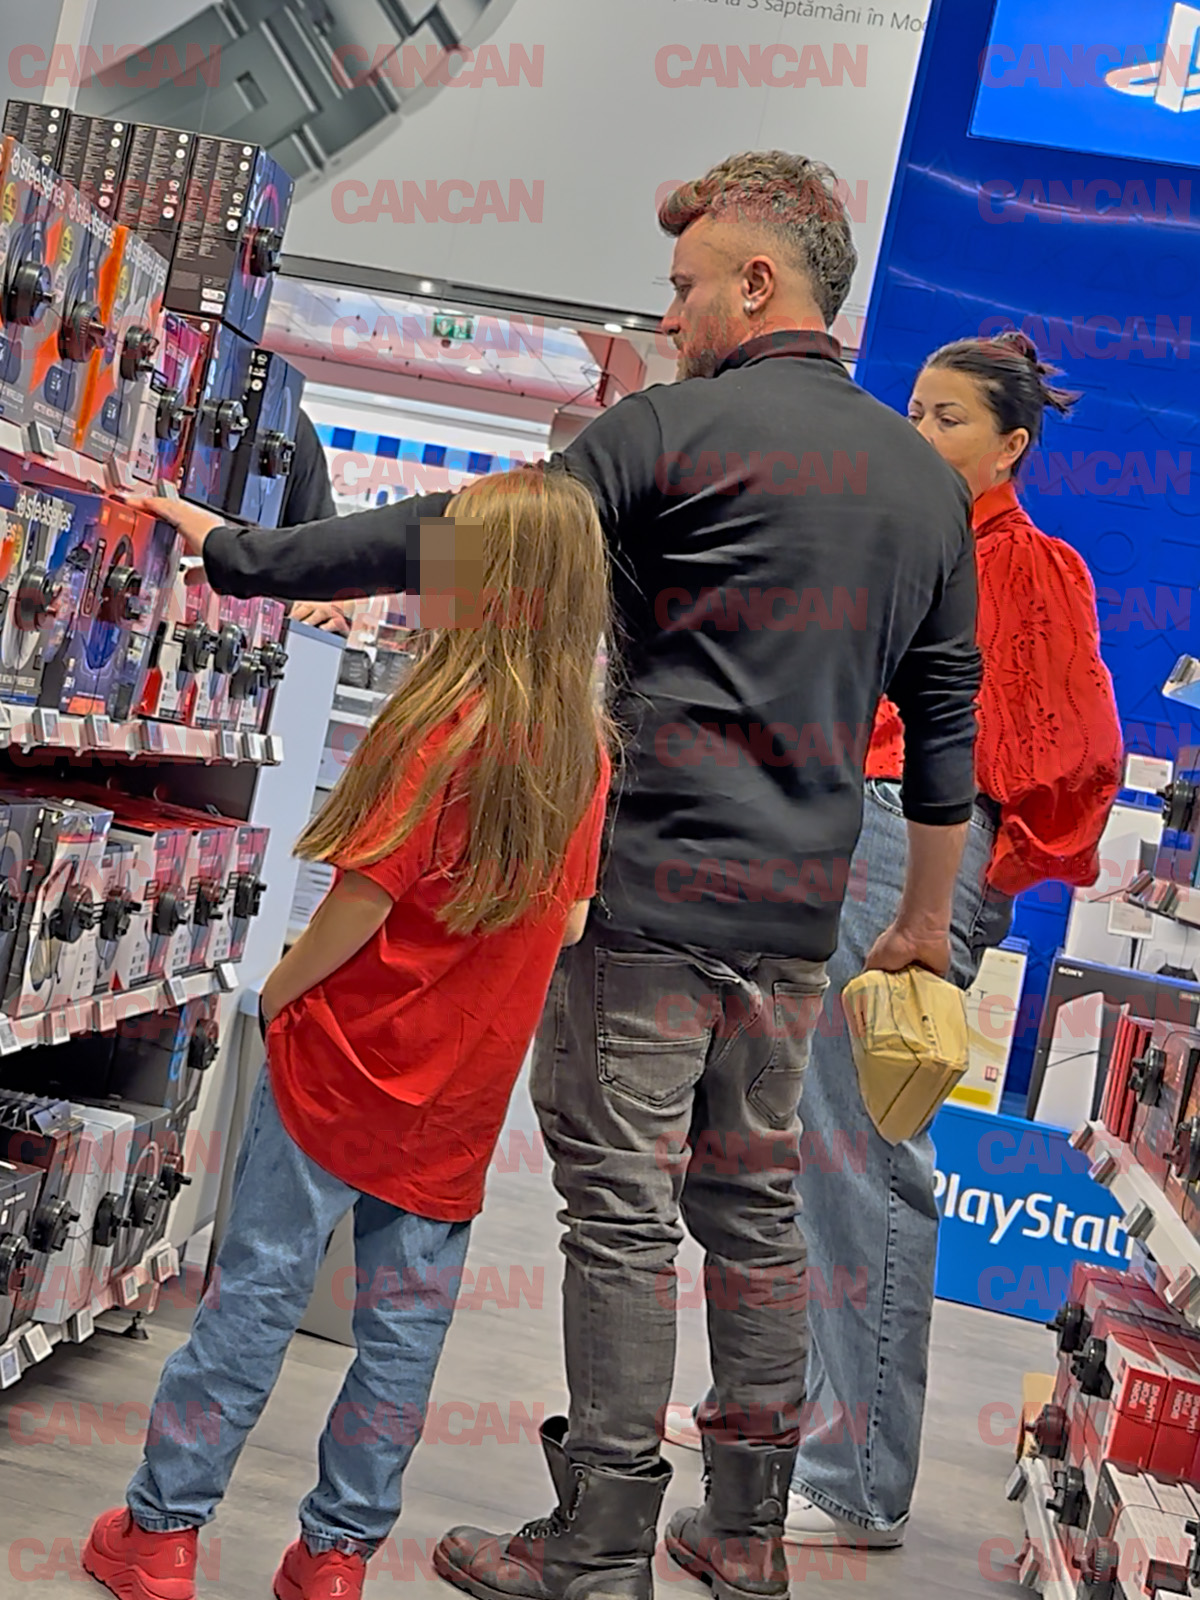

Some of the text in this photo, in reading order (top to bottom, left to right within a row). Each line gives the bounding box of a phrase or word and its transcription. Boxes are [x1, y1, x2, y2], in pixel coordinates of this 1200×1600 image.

[866, 8, 885, 27] în
[19, 155, 66, 210] steelseries
[1057, 966, 1085, 979] SONY
